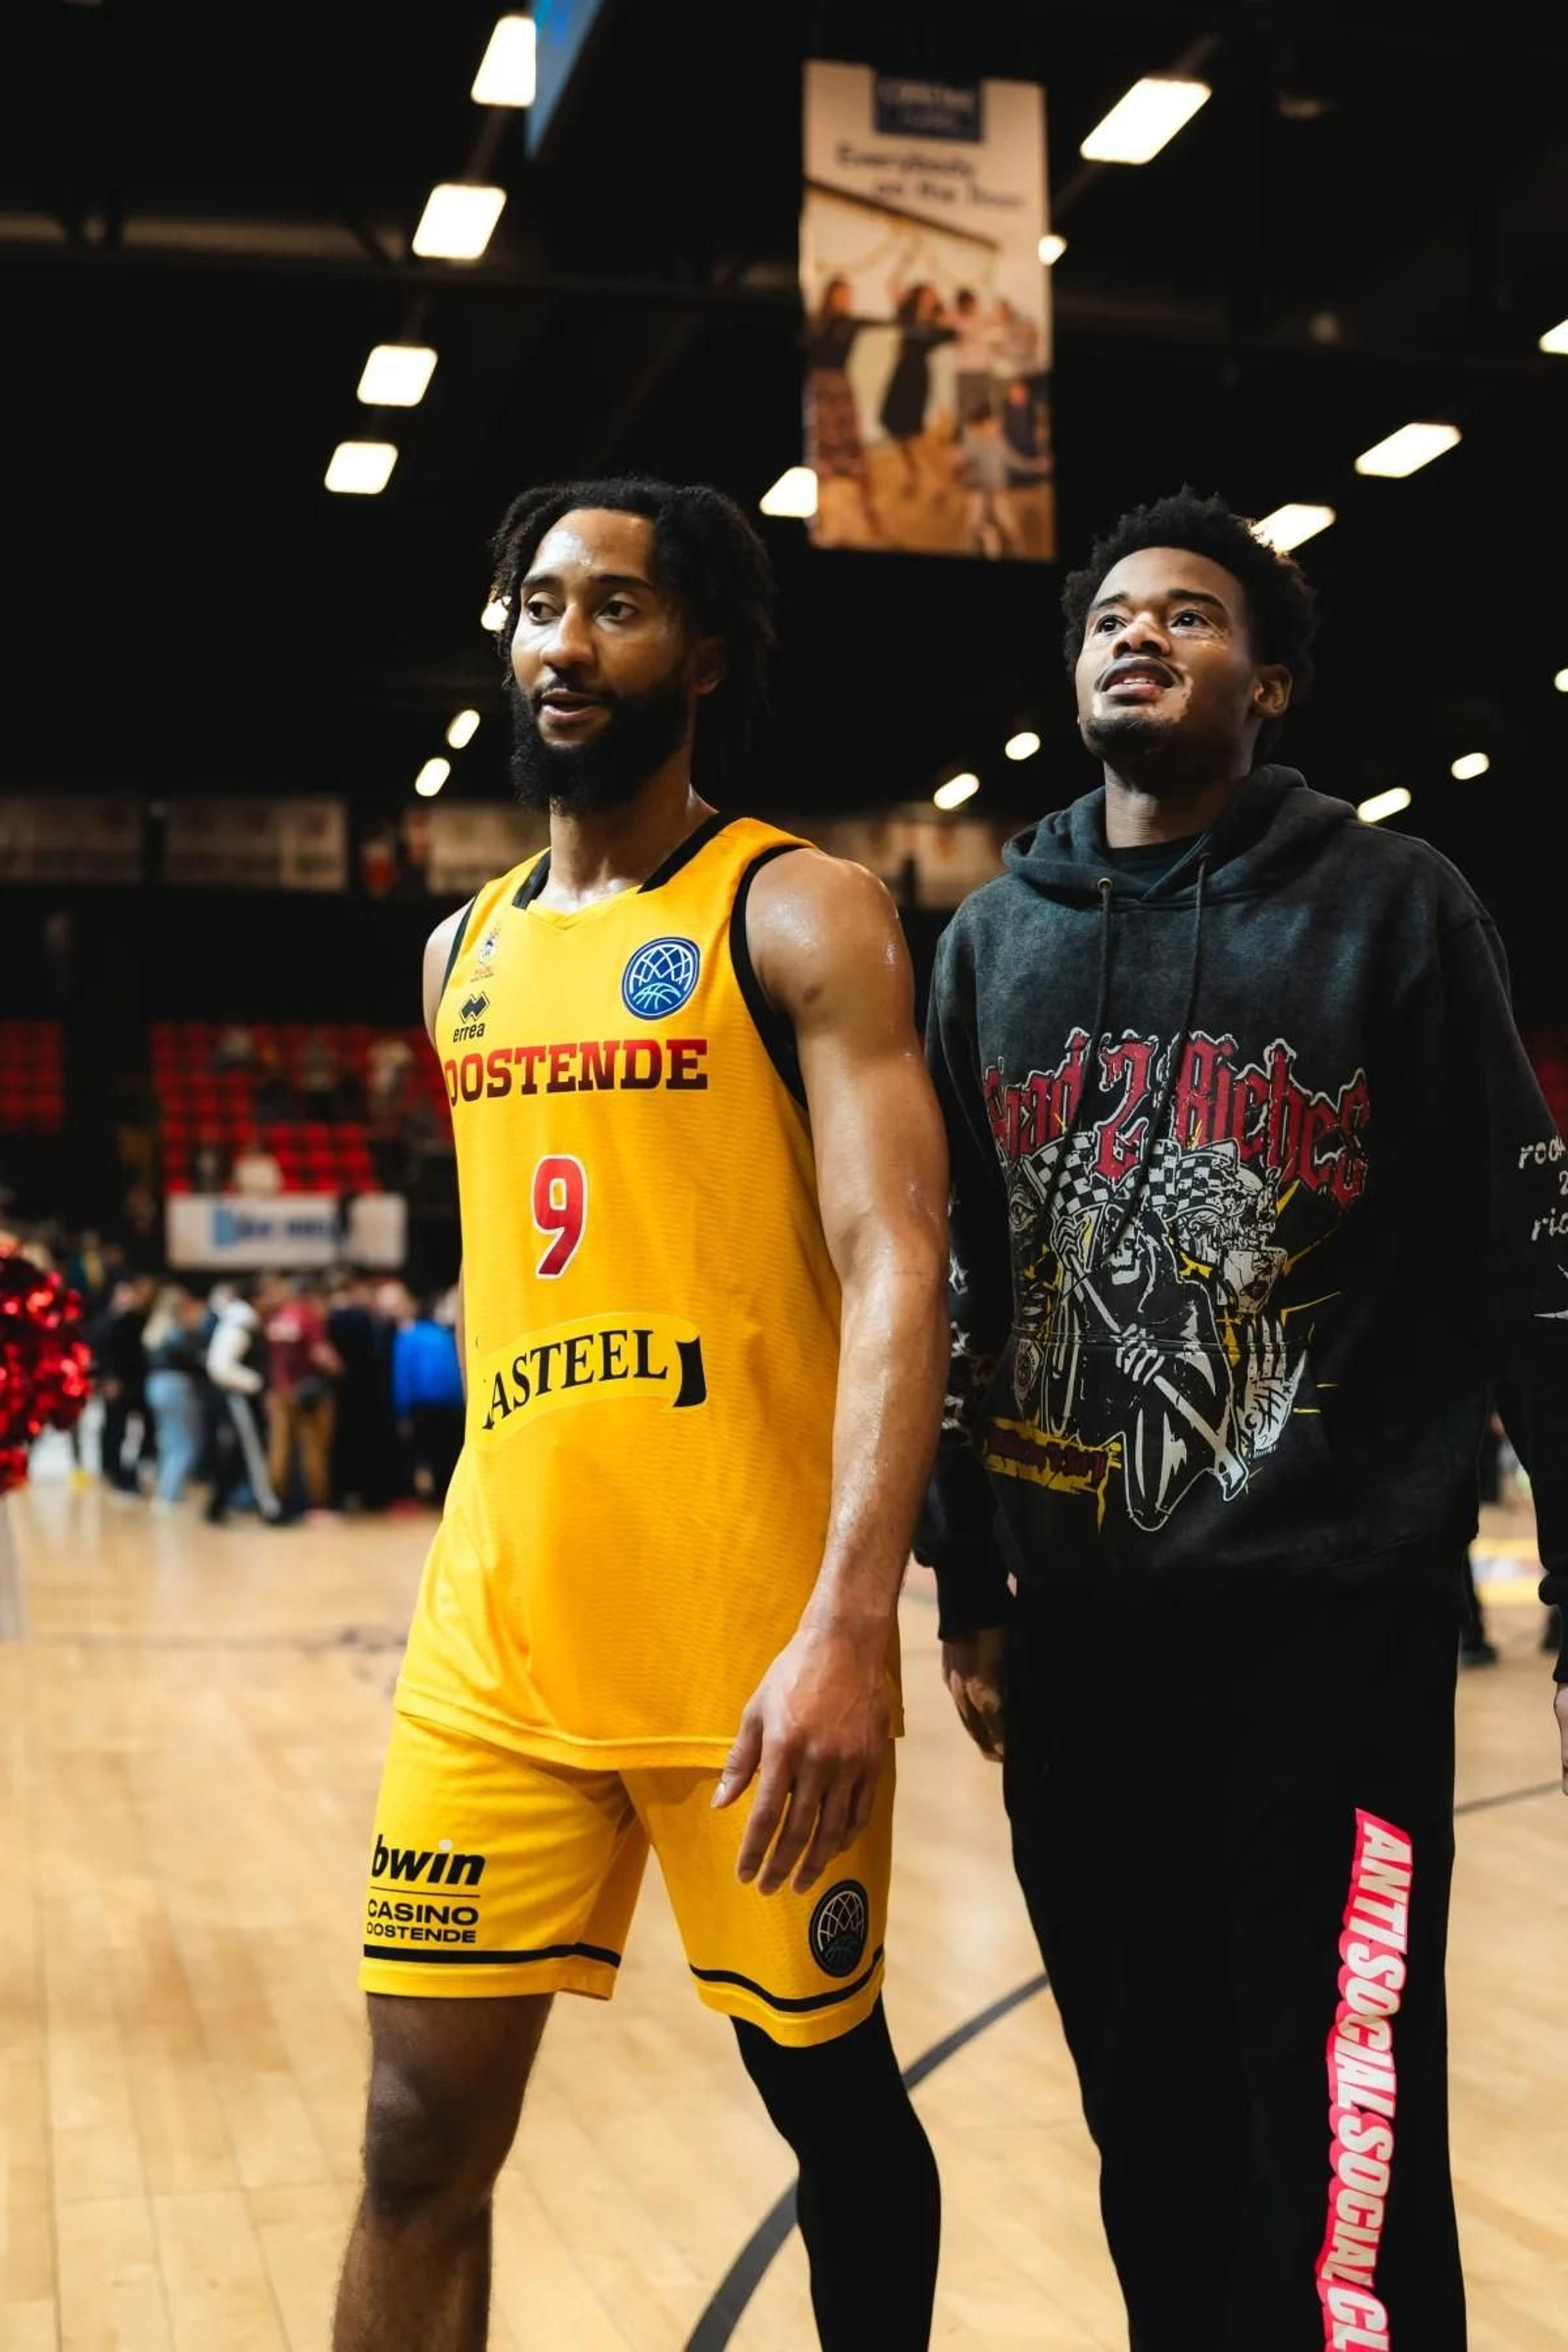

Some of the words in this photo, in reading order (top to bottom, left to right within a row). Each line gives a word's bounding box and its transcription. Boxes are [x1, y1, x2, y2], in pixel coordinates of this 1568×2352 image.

[445, 1039, 709, 1107] OOSTENDE
[1094, 1029, 1159, 1192] 2
[531, 1154, 588, 1279] 9
[482, 1330, 668, 1430] ASTEEL
[368, 1899, 479, 1926] CASINO
[371, 1834, 486, 1886] bwin
[1347, 1817, 1412, 1955] ANTI
[366, 1922, 476, 1943] OOSTENDE
[1333, 1941, 1406, 2120] SOCIAL
[1321, 2113, 1395, 2290] SOCIAL
